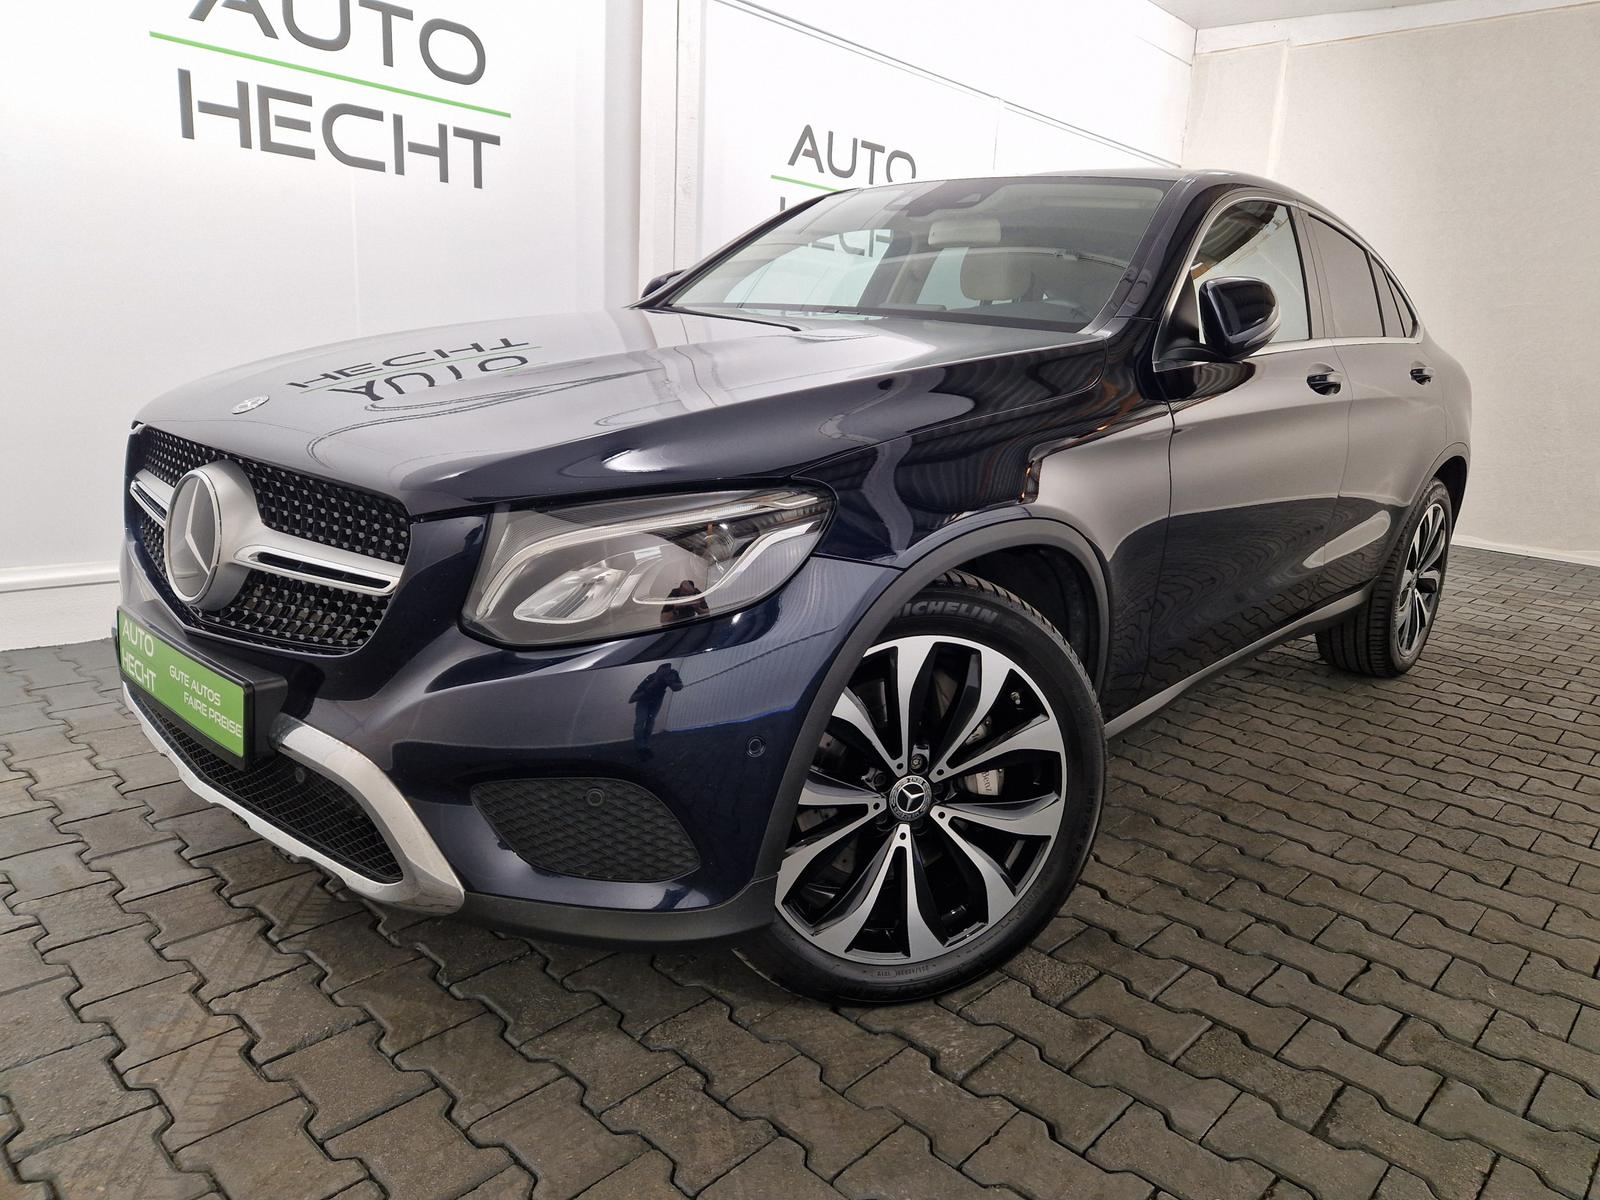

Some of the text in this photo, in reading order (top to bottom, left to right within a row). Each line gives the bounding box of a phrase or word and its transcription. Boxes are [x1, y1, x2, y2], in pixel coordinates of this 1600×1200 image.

[177, 67, 501, 190] HECHT
[787, 124, 917, 185] AUTO
[900, 600, 999, 624] ICHELIN
[122, 619, 154, 657] AUTO
[121, 647, 157, 692] HECHT
[169, 665, 221, 706] GUTE AUTOS
[183, 691, 242, 738] FAIRE PREISE
